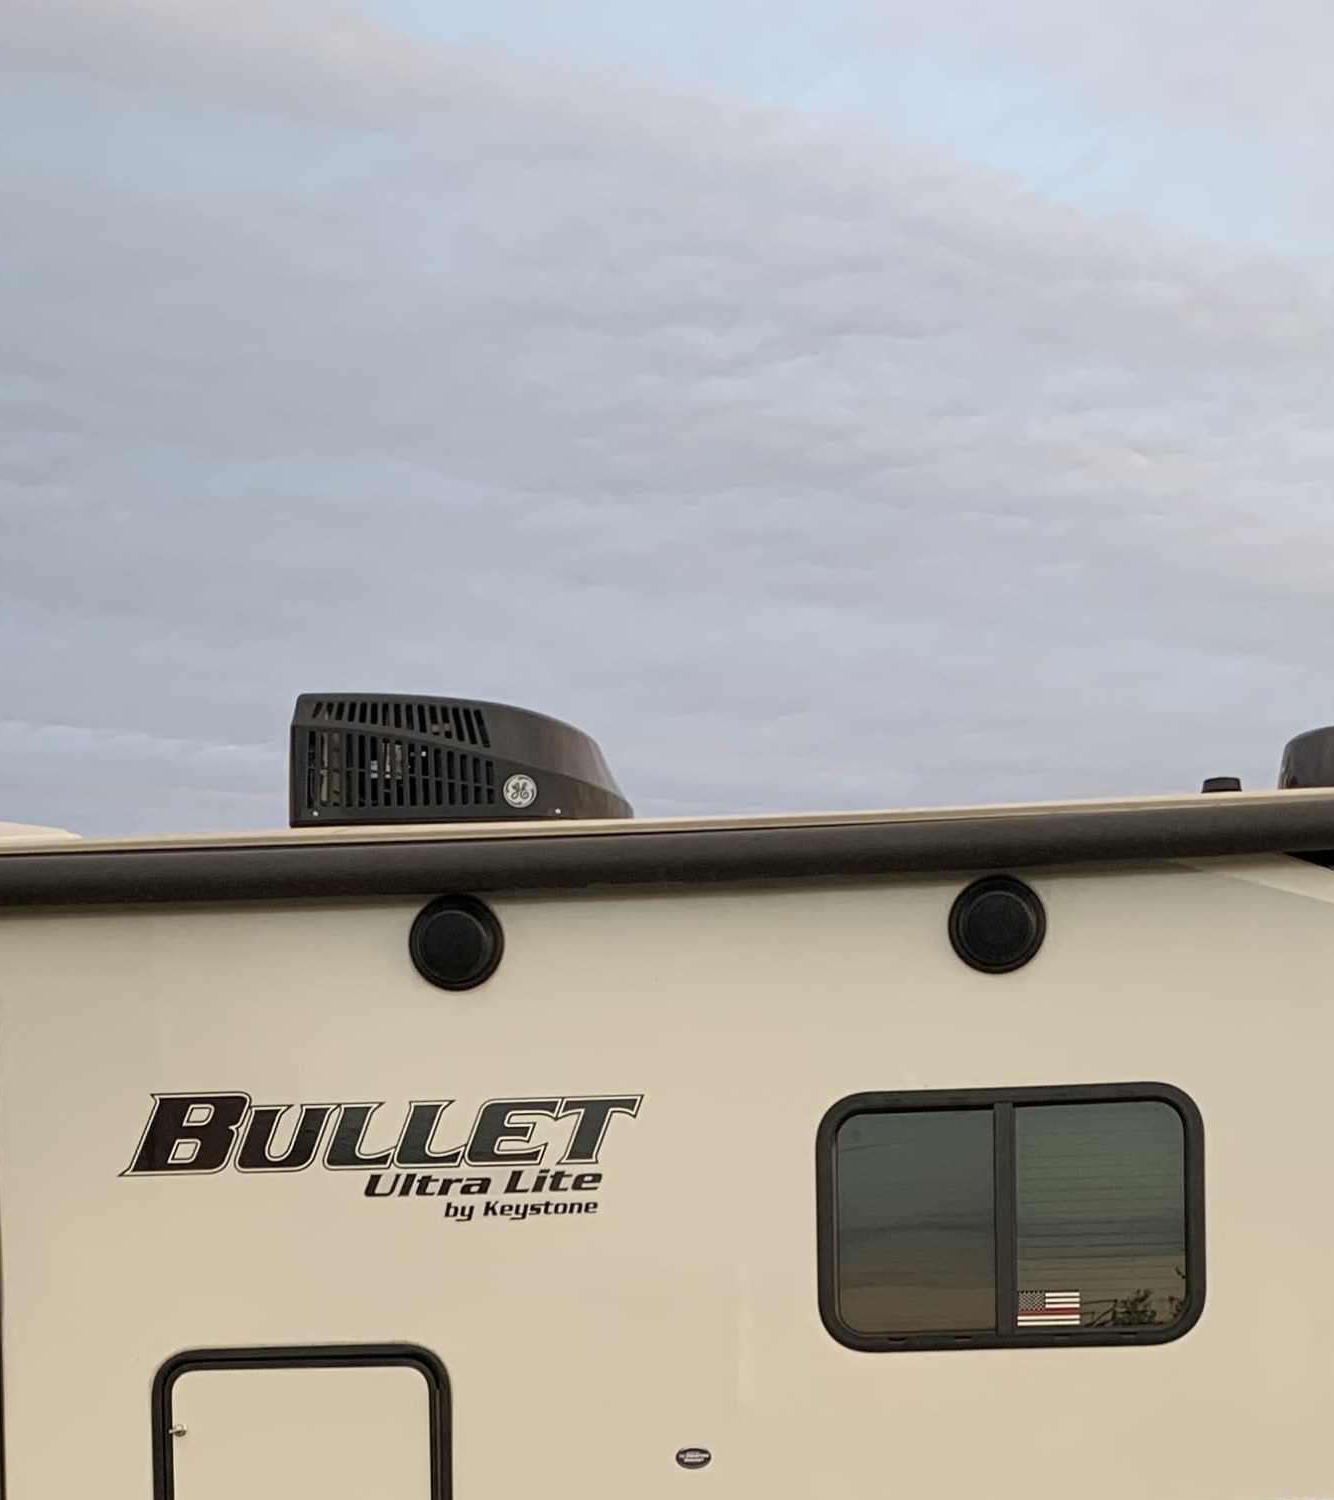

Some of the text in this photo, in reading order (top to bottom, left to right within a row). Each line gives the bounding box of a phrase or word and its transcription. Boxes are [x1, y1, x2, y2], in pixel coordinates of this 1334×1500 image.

[118, 1091, 644, 1177] BULLET
[363, 1169, 603, 1198] Ultra Lite
[443, 1200, 598, 1222] by Keystone
